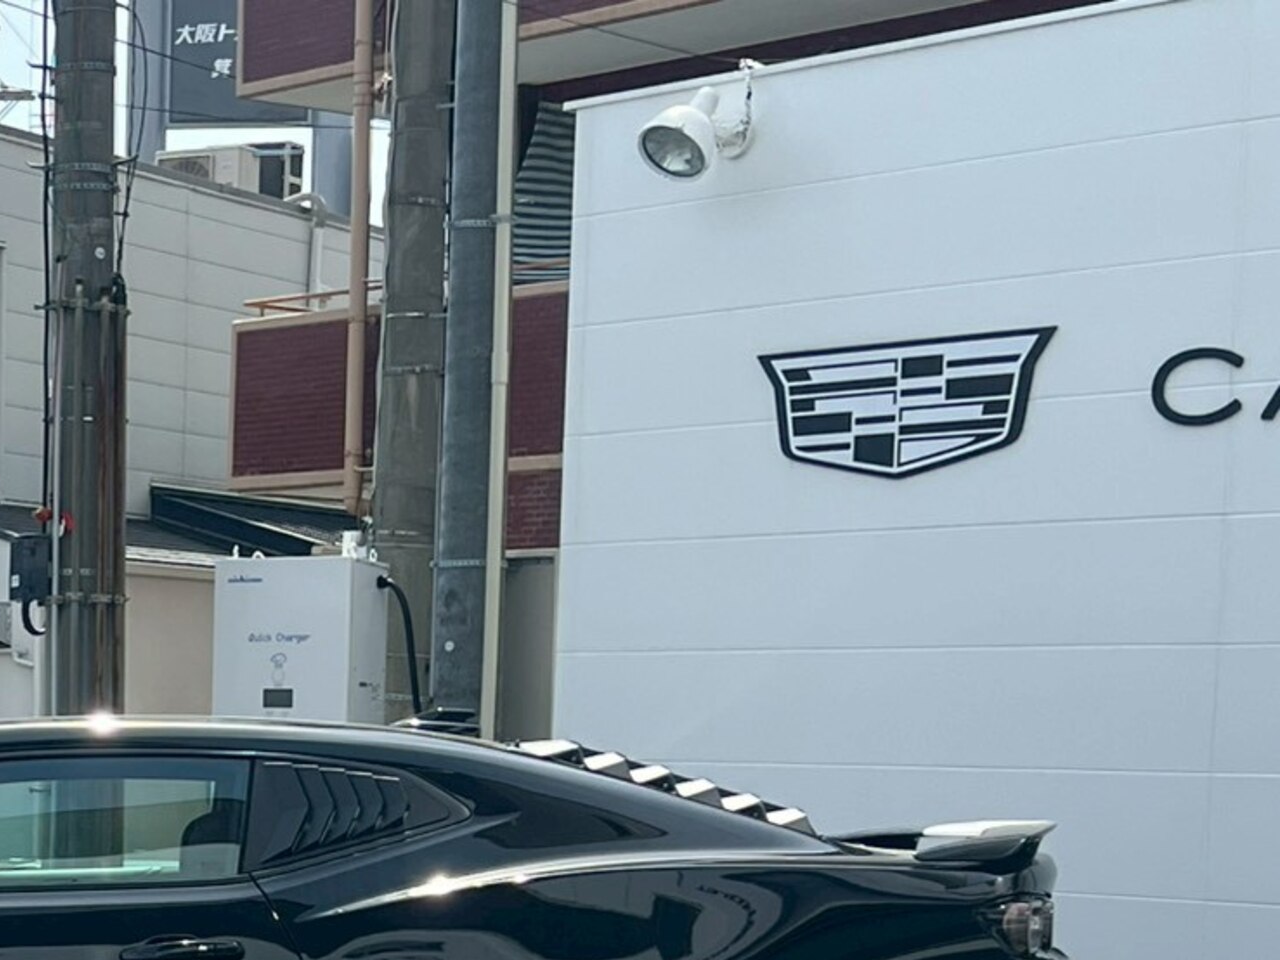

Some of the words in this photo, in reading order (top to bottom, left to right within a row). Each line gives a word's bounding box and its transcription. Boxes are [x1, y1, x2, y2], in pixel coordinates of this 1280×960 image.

[174, 23, 239, 45] 大阪ト
[1151, 346, 1280, 426] C
